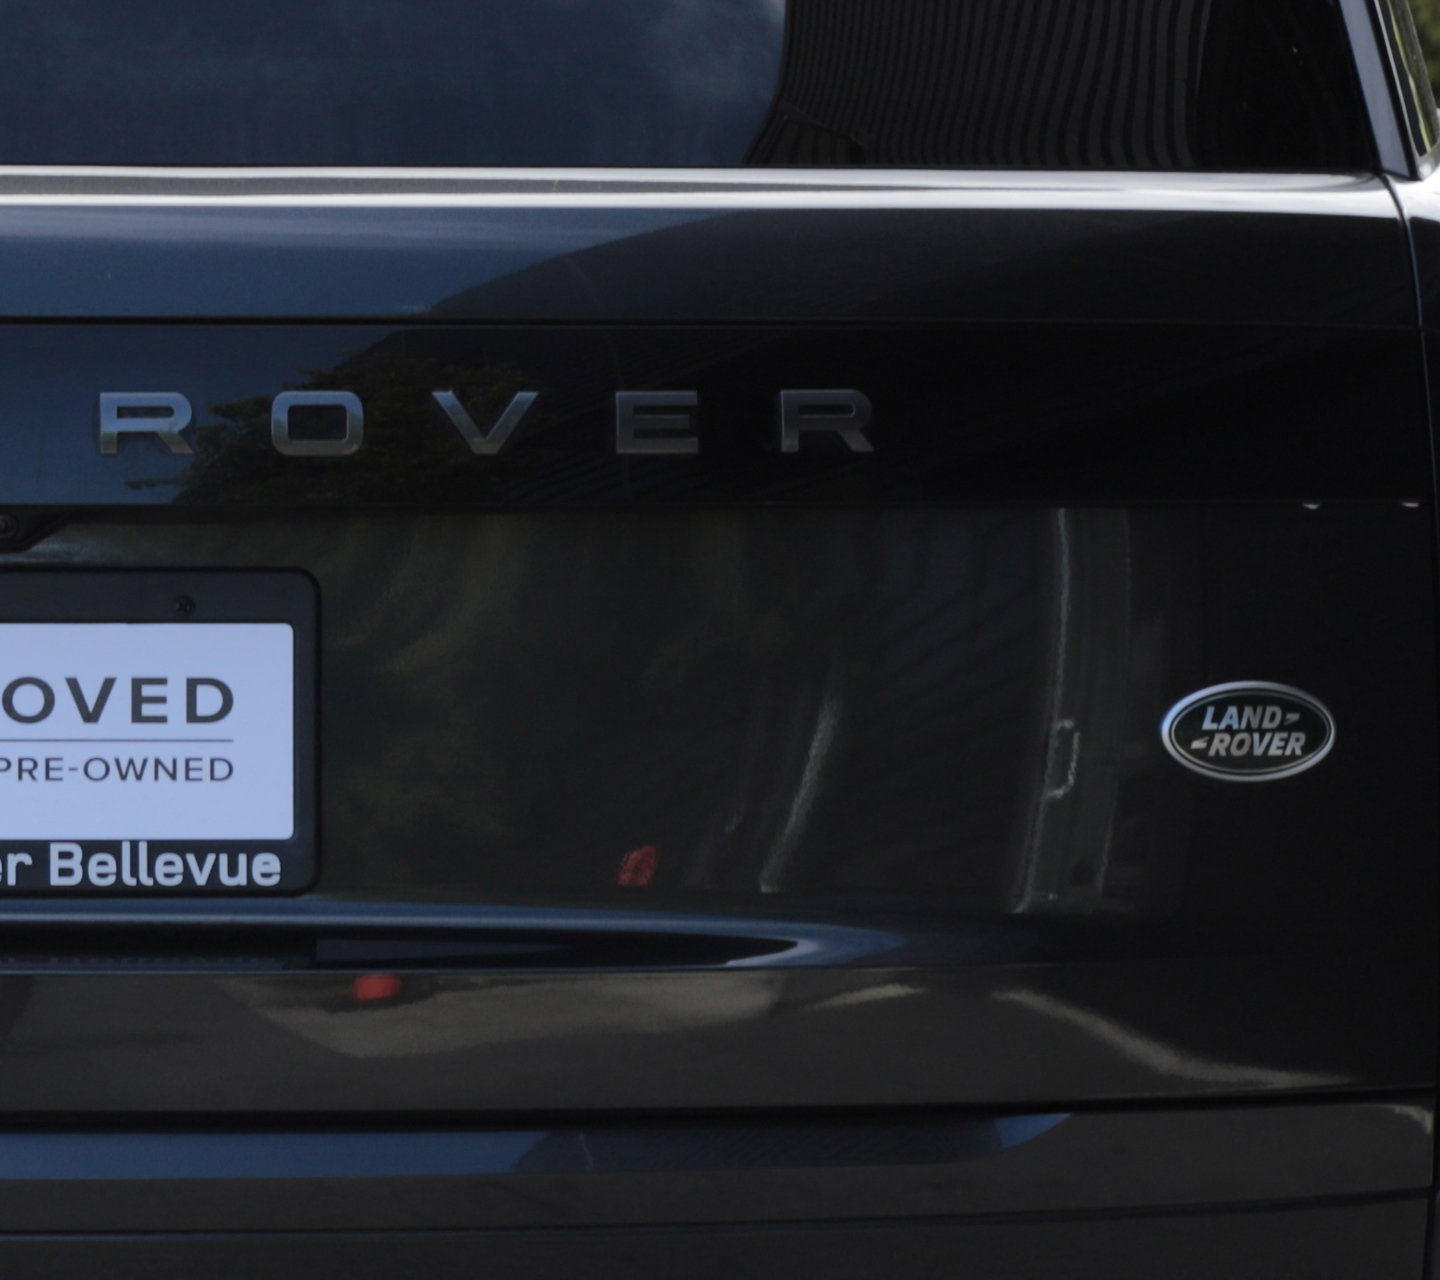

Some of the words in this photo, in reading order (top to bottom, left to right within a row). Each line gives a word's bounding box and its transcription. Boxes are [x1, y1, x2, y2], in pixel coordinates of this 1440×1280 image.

[97, 388, 876, 456] ROVER
[1202, 705, 1282, 730] LAND
[1208, 732, 1306, 756] ROVER
[48, 840, 283, 888] Bellevue
